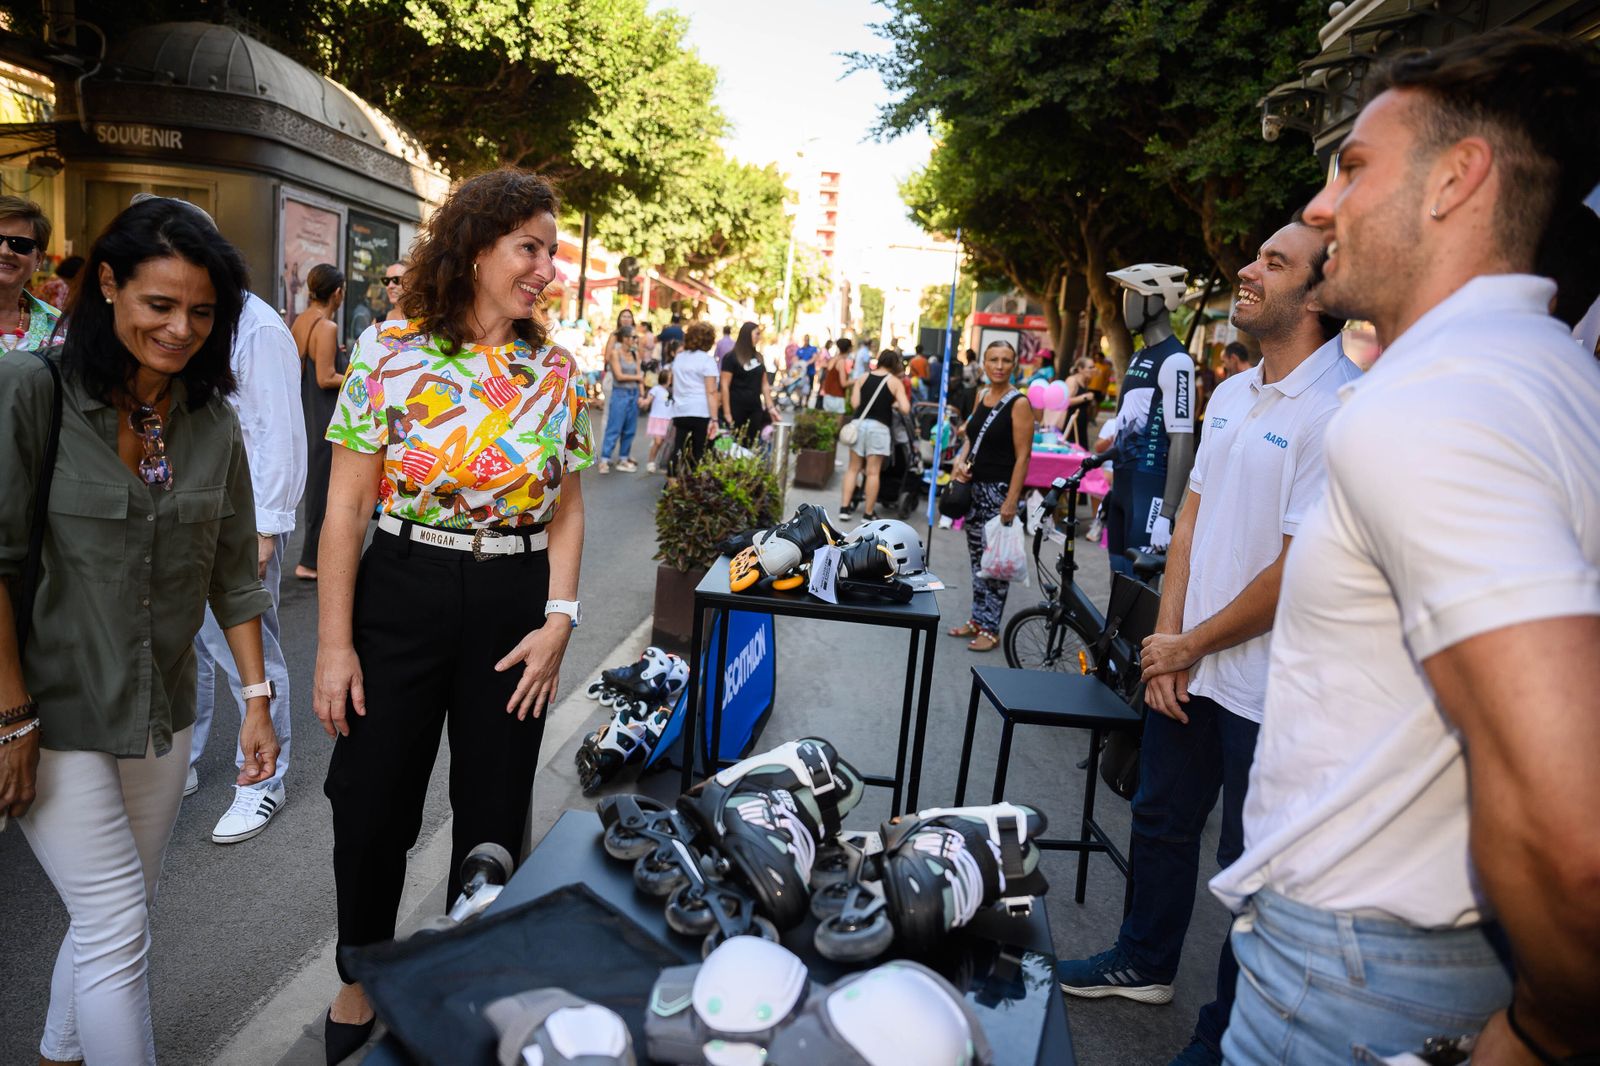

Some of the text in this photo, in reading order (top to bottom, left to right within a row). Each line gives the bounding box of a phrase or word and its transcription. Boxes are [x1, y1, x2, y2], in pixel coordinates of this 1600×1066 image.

[97, 125, 183, 149] SOUVENIR
[1177, 373, 1188, 417] MAVIC
[1146, 400, 1164, 467] OCKRIDER
[1263, 432, 1288, 449] AARO
[420, 530, 455, 546] MORGAN
